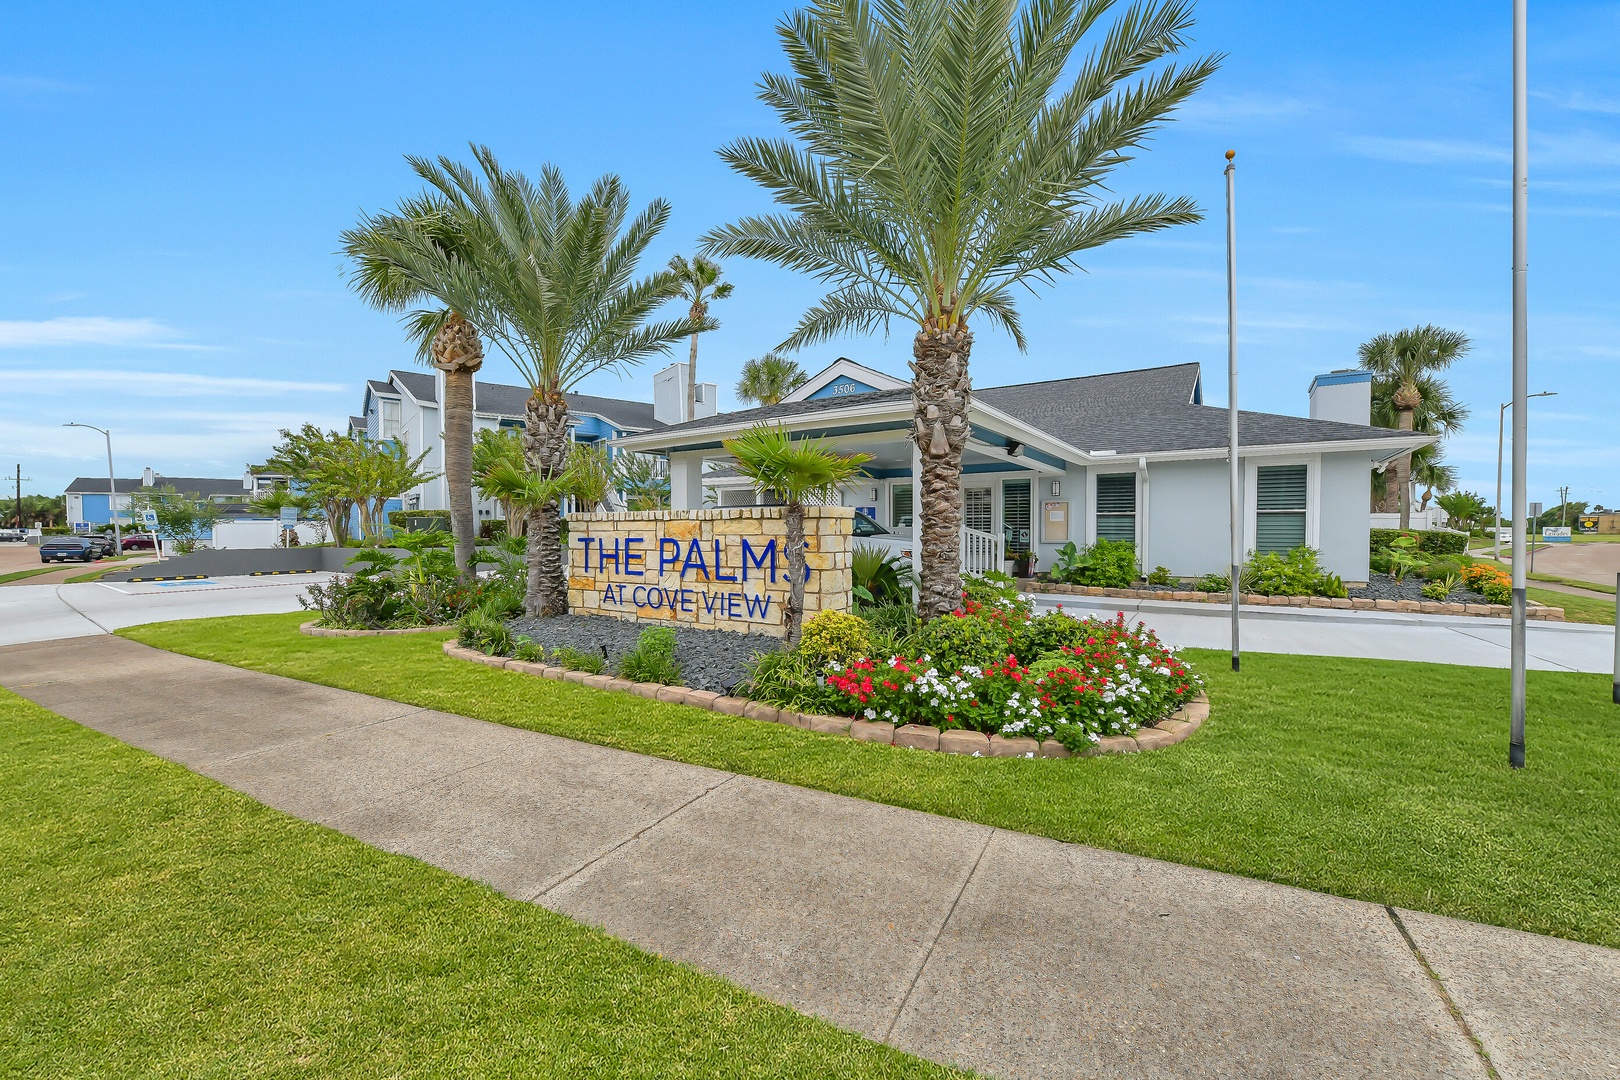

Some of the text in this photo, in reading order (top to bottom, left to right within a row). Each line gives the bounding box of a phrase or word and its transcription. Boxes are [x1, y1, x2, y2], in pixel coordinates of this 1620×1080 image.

[832, 383, 856, 395] 3506
[577, 537, 645, 576] THE
[602, 583, 771, 619] AT COVE VIEW
